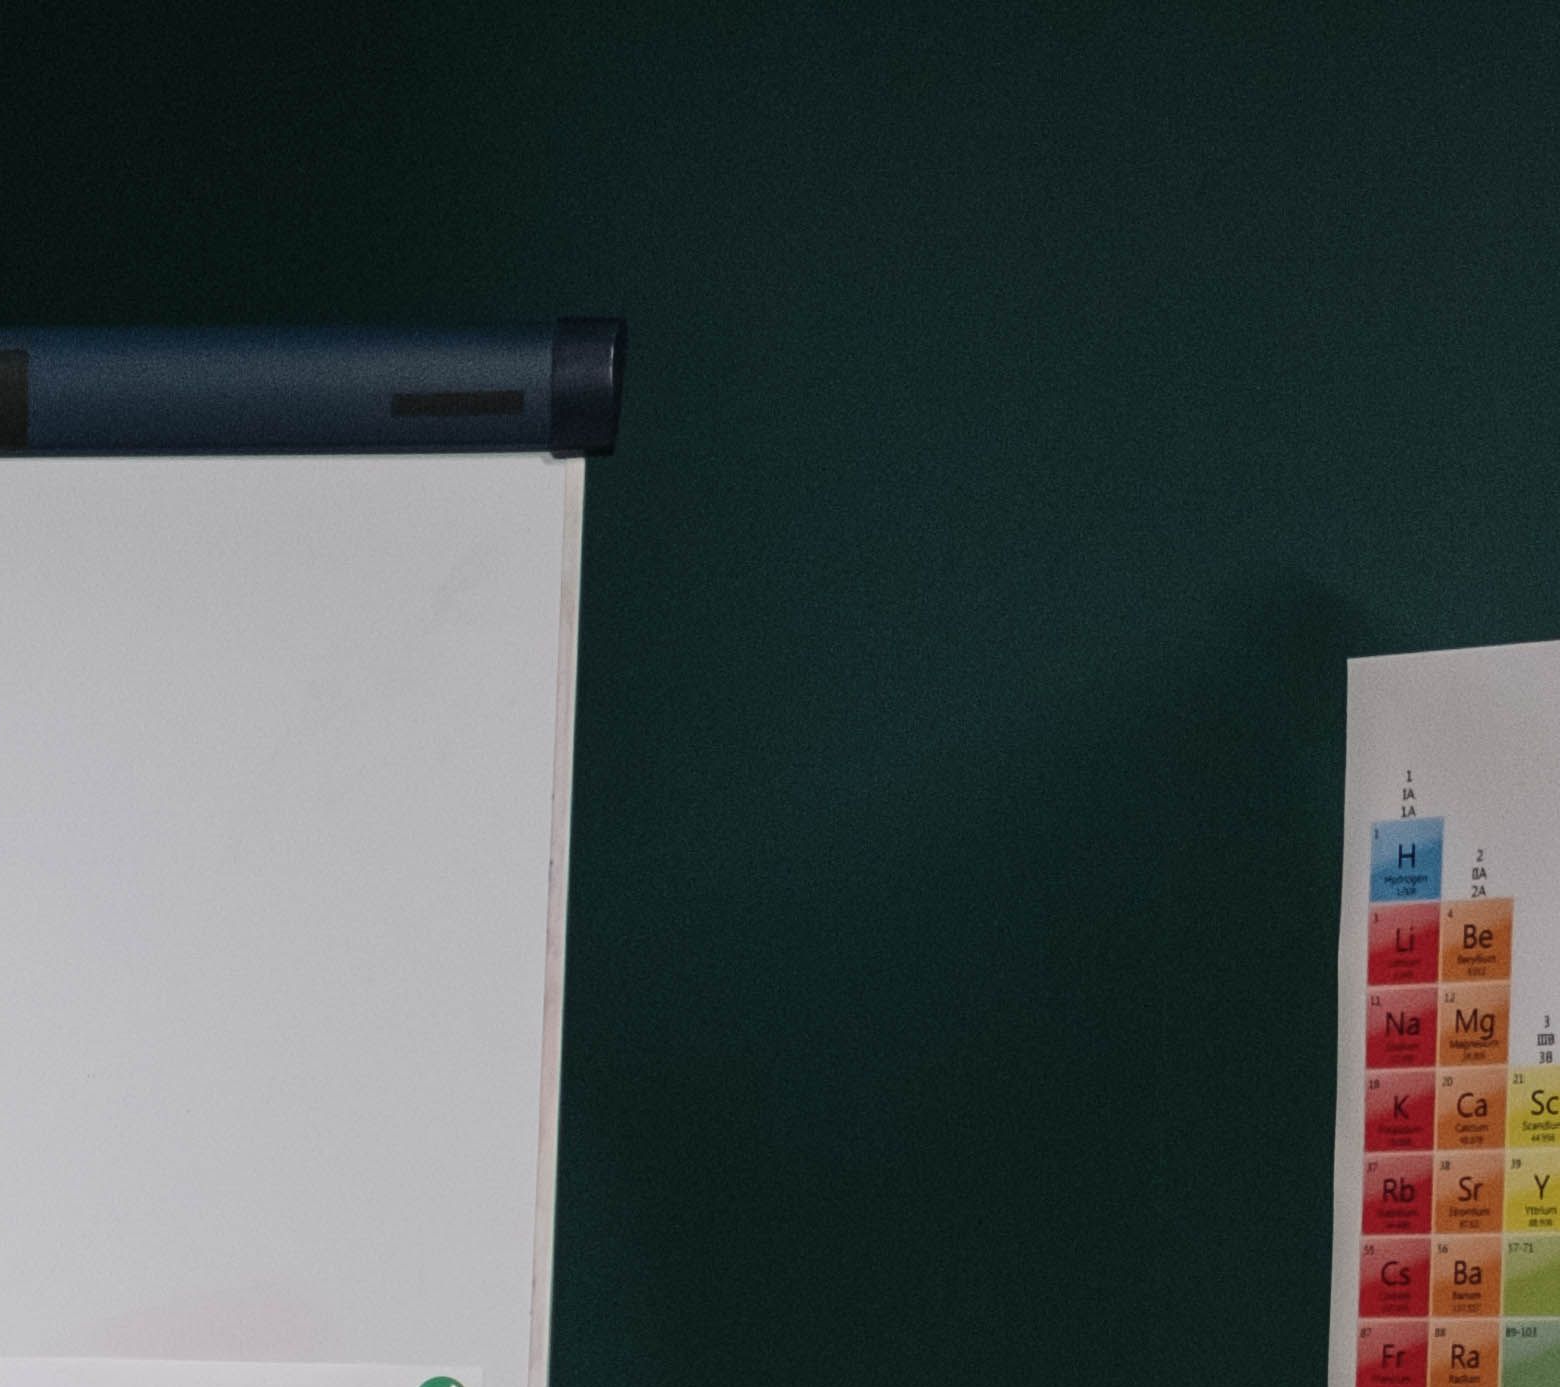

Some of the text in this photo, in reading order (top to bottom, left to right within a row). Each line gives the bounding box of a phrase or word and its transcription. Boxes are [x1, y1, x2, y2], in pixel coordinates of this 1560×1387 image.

[1407, 770, 1412, 783] 1
[1398, 844, 1415, 868] H
[1396, 928, 1414, 953] Li
[1463, 924, 1492, 949] Be
[1386, 1011, 1420, 1036] Na
[1456, 1010, 1496, 1039] Mg
[1394, 1095, 1409, 1119] K
[1457, 1092, 1487, 1118] Ca
[1531, 1090, 1559, 1116] Sc
[1459, 1177, 1483, 1201] Sr
[1535, 1175, 1550, 1199] Y
